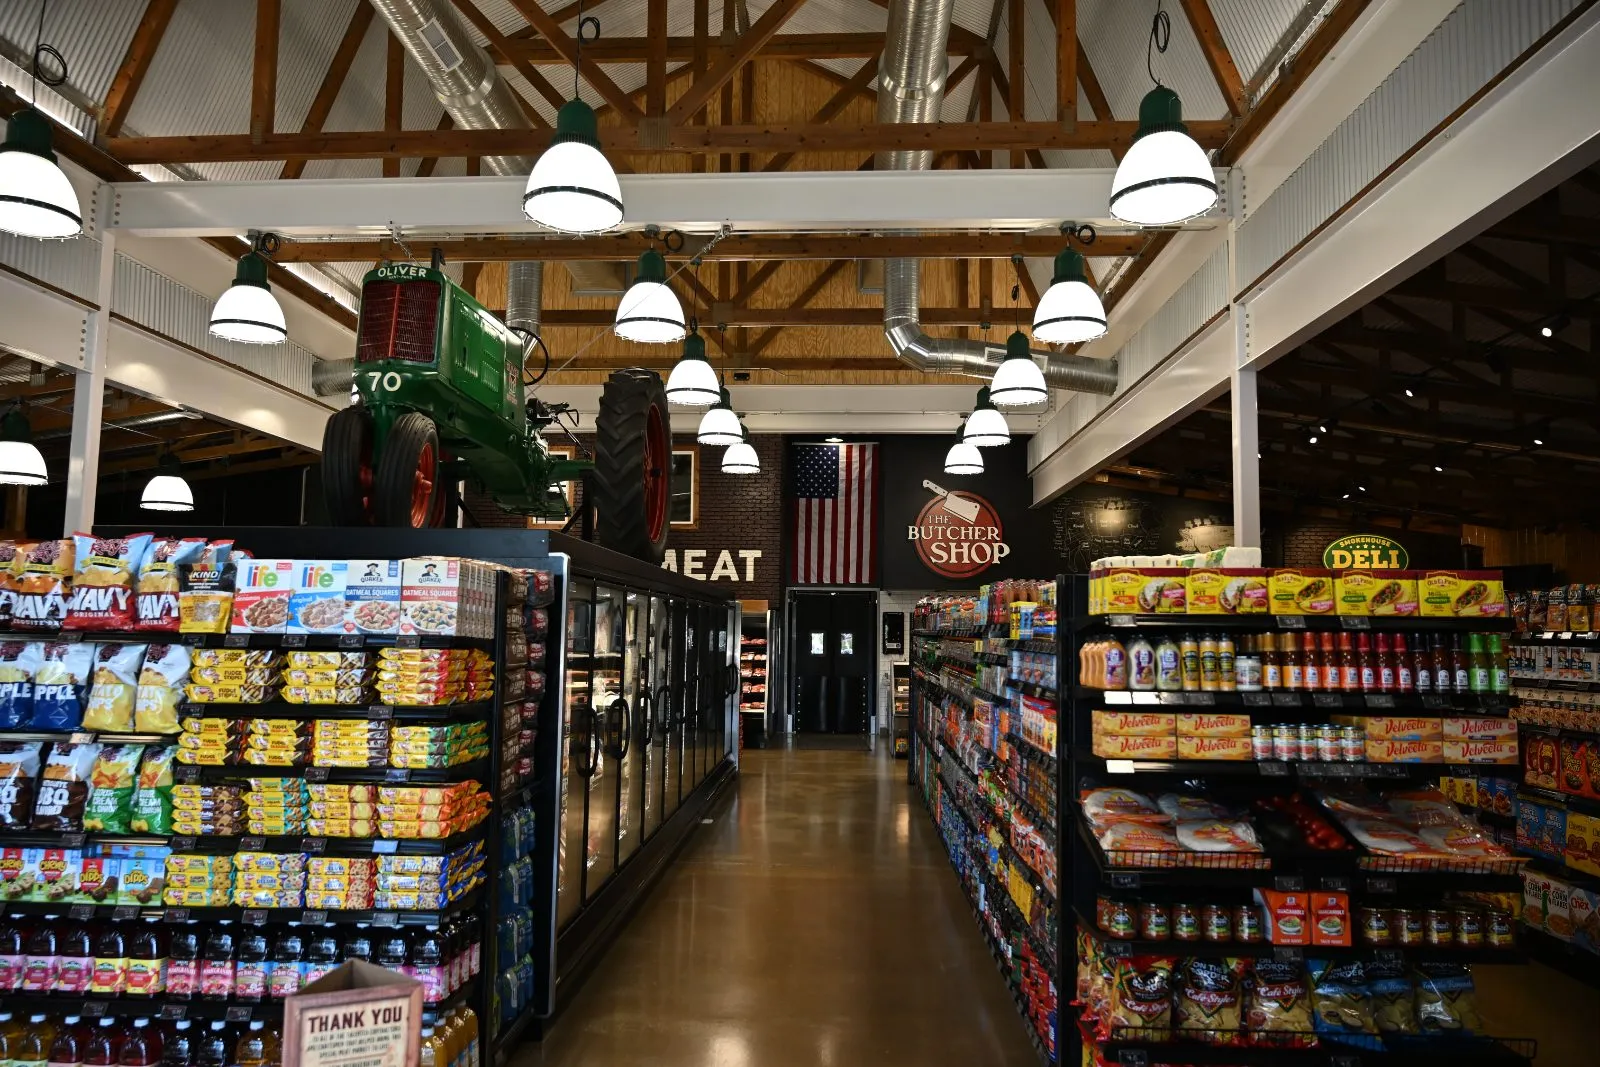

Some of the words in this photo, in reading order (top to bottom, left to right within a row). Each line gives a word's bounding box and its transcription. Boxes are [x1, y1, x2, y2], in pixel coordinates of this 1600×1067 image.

[378, 266, 427, 278] OLIVER
[368, 372, 402, 392] 70
[926, 515, 952, 525] THE
[908, 525, 1001, 541] BUTCHER
[1340, 537, 1391, 548] SMOKEHOUSE
[929, 542, 1011, 564] SHOP
[1331, 549, 1400, 569] DELI
[247, 566, 279, 588] life
[302, 565, 334, 588] life
[346, 588, 371, 597] OATMEAL
[372, 589, 399, 597] SQUARES
[403, 589, 429, 597] OATMEAL
[429, 589, 457, 598] SQUARES
[138, 594, 180, 619] AVY
[74, 611, 116, 619] ORIGINAL
[0, 684, 31, 698] PLE
[34, 684, 76, 701] PPLE
[1120, 715, 1161, 731] Velveeta
[1195, 715, 1236, 732] Velveeta
[1385, 718, 1426, 735] Velveeta
[1462, 719, 1503, 736] Velveeta
[1121, 738, 1162, 753] Velveeta
[1196, 738, 1237, 754] Velveeta
[1387, 741, 1428, 758] Velveeta
[1462, 741, 1503, 758] Velveeta
[93, 797, 119, 806] CREAM
[80, 872, 103, 883] DIPPS
[124, 873, 149, 885] DIPPS
[1552, 890, 1568, 903] CORN
[1193, 961, 1207, 970] ON
[1283, 985, 1304, 997] Style
[308, 1011, 365, 1034] THANK
[372, 1006, 402, 1025] YOU
